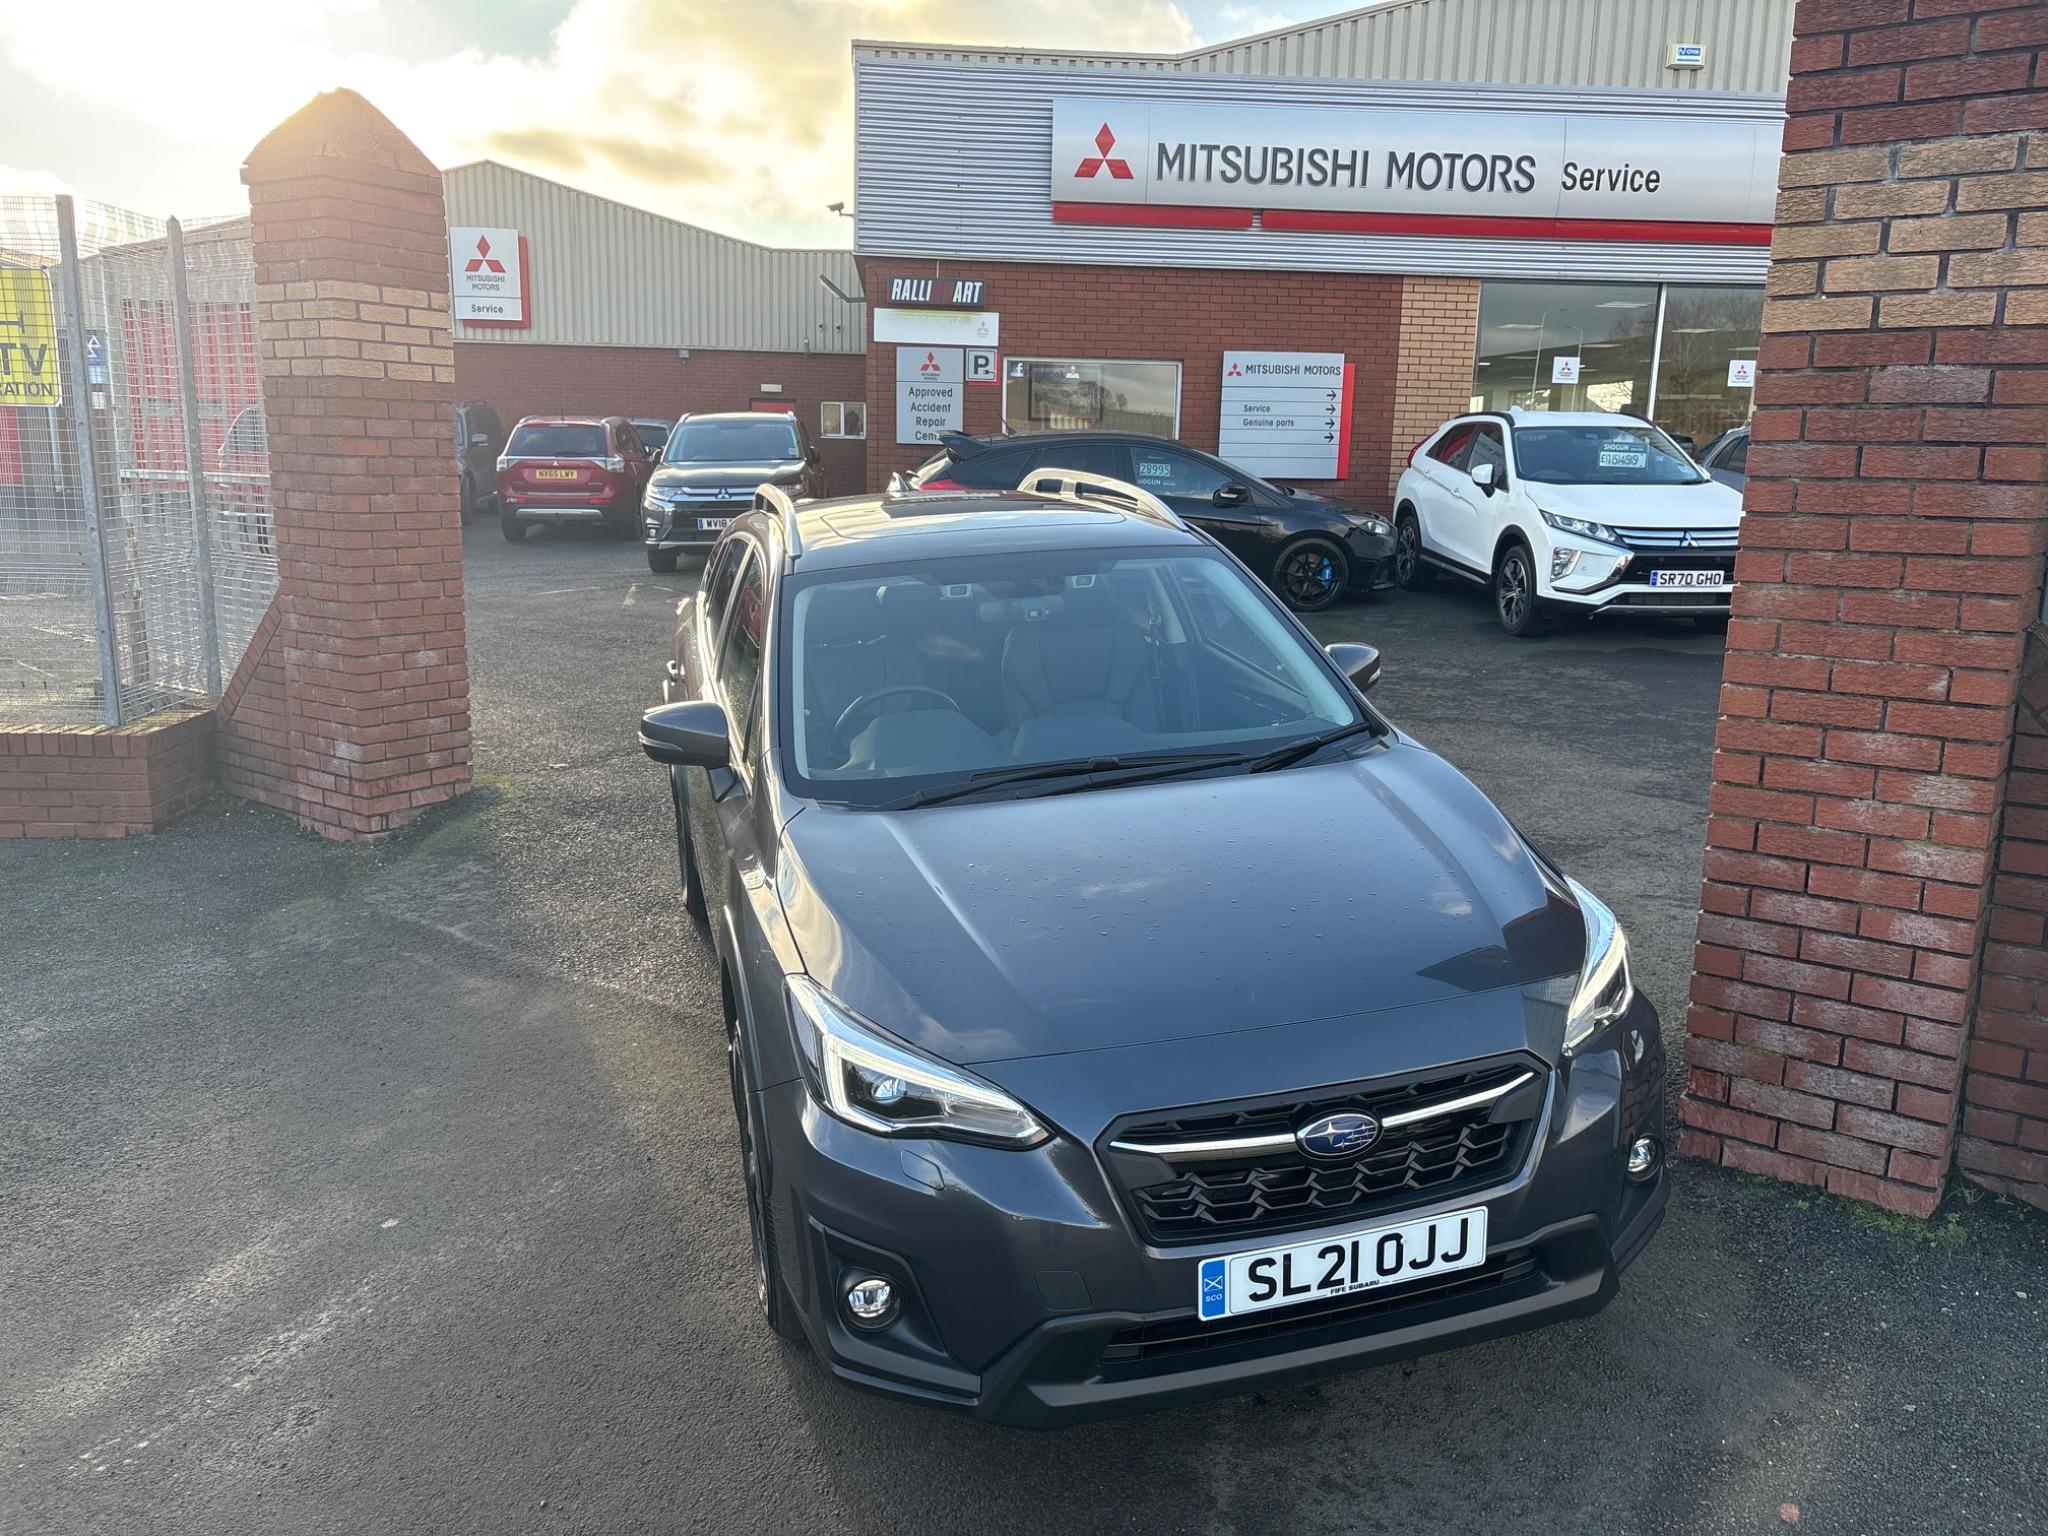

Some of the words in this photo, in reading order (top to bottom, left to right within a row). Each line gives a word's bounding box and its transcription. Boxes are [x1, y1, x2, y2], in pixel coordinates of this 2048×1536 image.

[1155, 142, 1369, 188] MITSUBISHI
[1386, 150, 1537, 193] MOTORS
[1561, 161, 1661, 193] Service
[466, 274, 505, 283] MITSUBISHI
[472, 283, 500, 291] MOTORS
[952, 281, 983, 303] ART
[471, 304, 503, 313] Service
[973, 355, 990, 375] P
[1245, 364, 1300, 375] MITSUBISHI
[1303, 365, 1341, 376] MOTORS
[908, 386, 953, 398] Approved
[910, 401, 951, 413] Accident
[1243, 404, 1271, 413] Service
[915, 416, 947, 428] Repair
[1243, 418, 1274, 427] Genuine
[1276, 419, 1295, 428] parts
[1140, 464, 1170, 476] 28995
[1660, 573, 1693, 585] SR70
[1248, 1240, 1360, 1302] SL21
[1376, 1217, 1469, 1277] OJJ
[1330, 1285, 1347, 1295] FIFE
[1348, 1279, 1380, 1291] SUBARU
[1205, 1293, 1223, 1302] SCO
